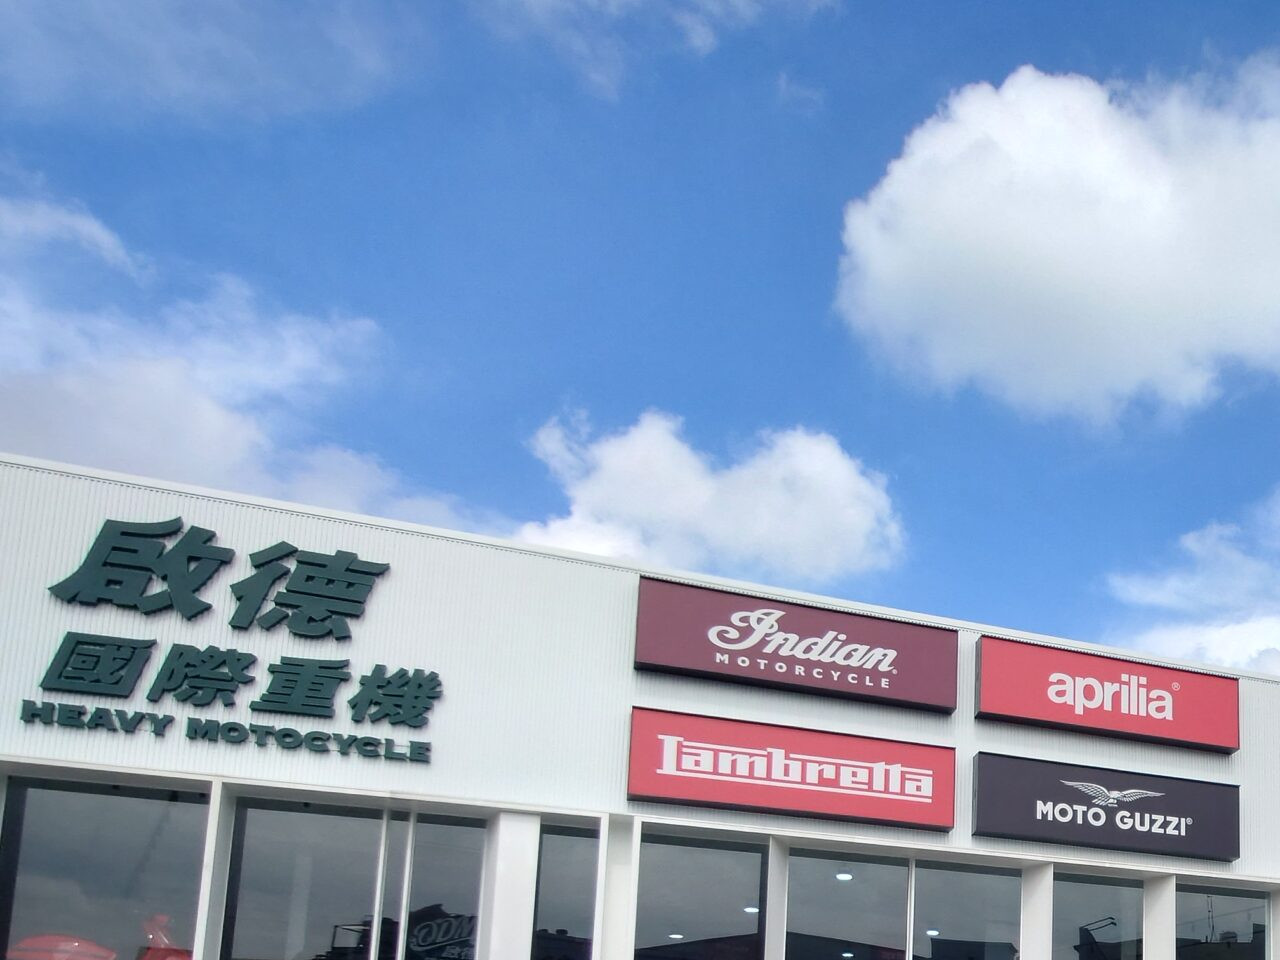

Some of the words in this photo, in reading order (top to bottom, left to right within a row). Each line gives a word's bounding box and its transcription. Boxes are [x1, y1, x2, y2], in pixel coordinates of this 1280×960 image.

[48, 516, 391, 641] 啟德
[707, 608, 898, 672] Indian
[715, 652, 890, 689] MOTORCYCLE
[40, 631, 443, 728] 國際重機
[1047, 672, 1174, 721] aprilia
[20, 699, 175, 737] HEAVY
[186, 716, 432, 763] MOTOCYCLE
[656, 734, 933, 803] Lambretta
[1036, 800, 1106, 827] MOTO
[1115, 810, 1186, 836] GUZZI
